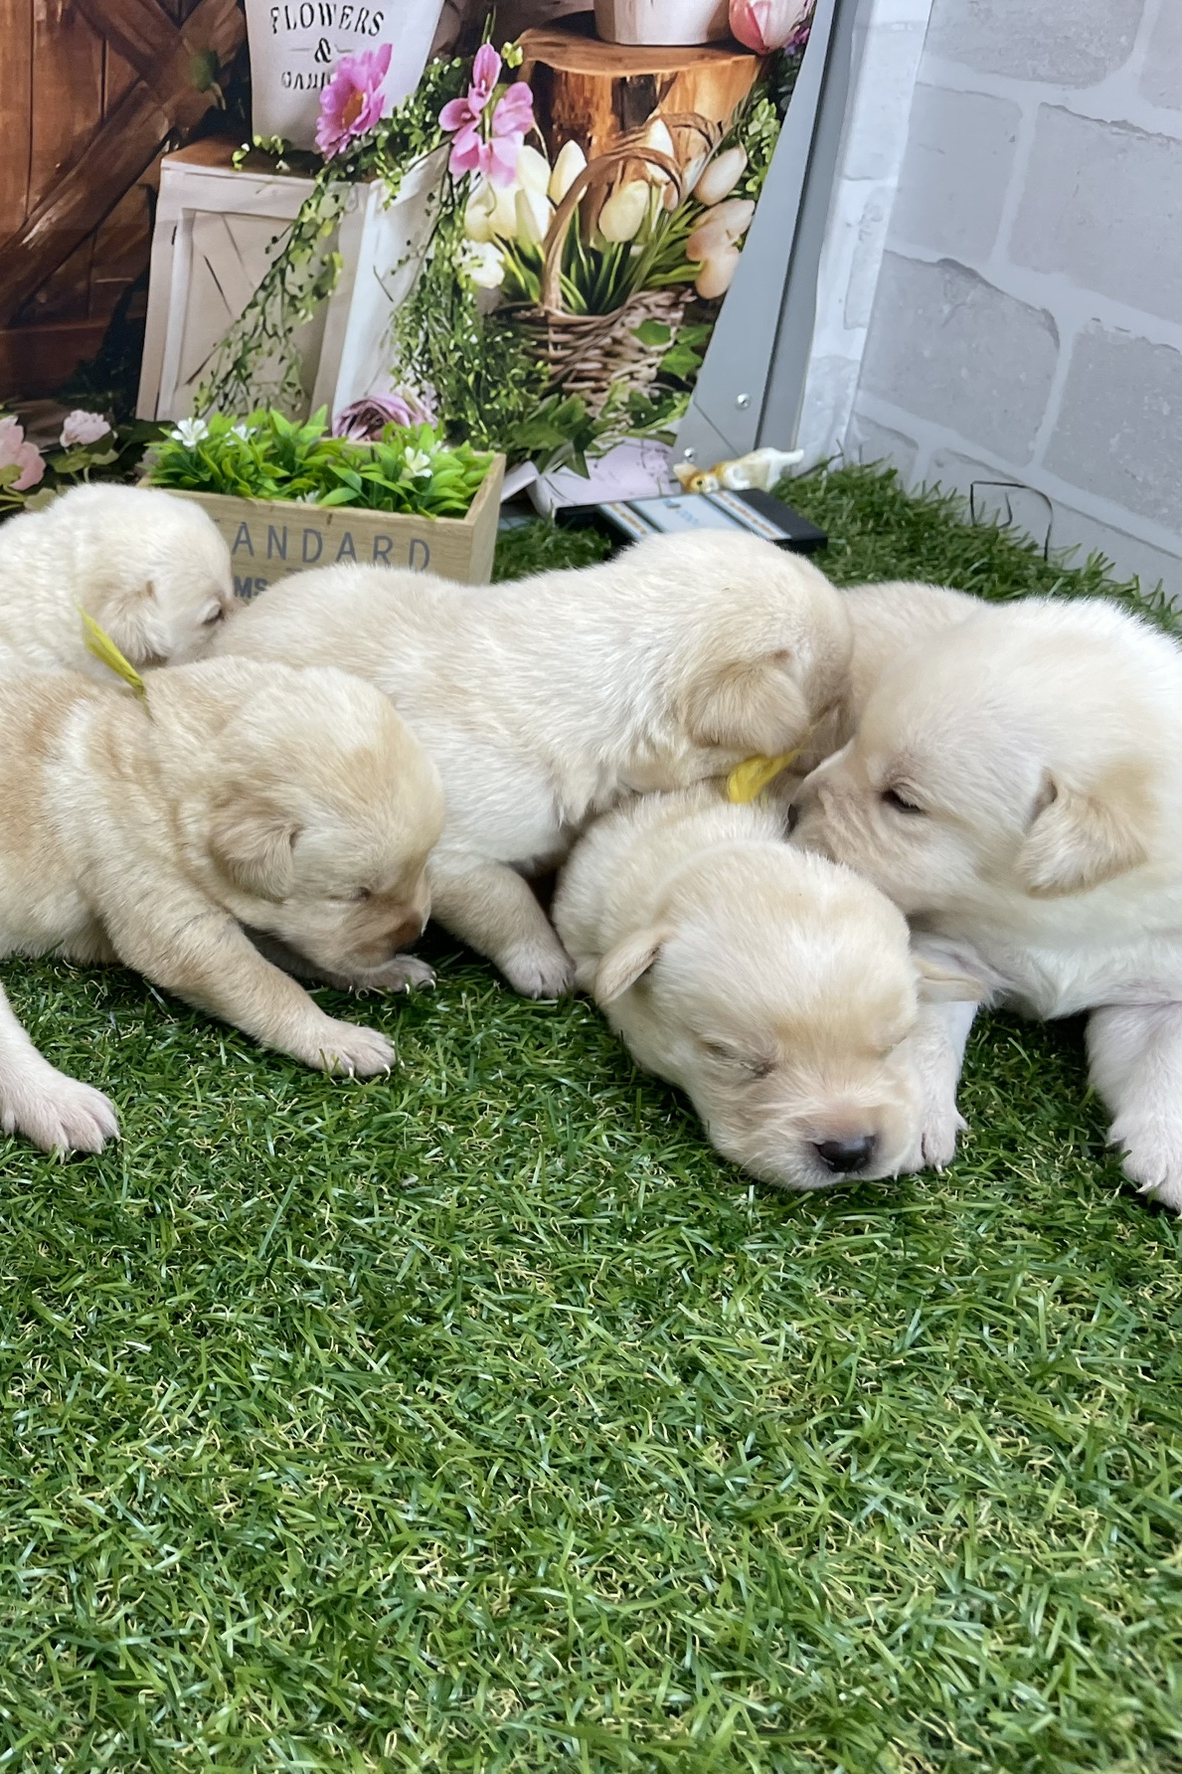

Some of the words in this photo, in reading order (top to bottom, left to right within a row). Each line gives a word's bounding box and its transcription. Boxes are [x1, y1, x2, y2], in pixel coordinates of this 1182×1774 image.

[271, 2, 384, 36] FLOWERS
[314, 37, 332, 63] &
[214, 518, 430, 572] ANDARD
